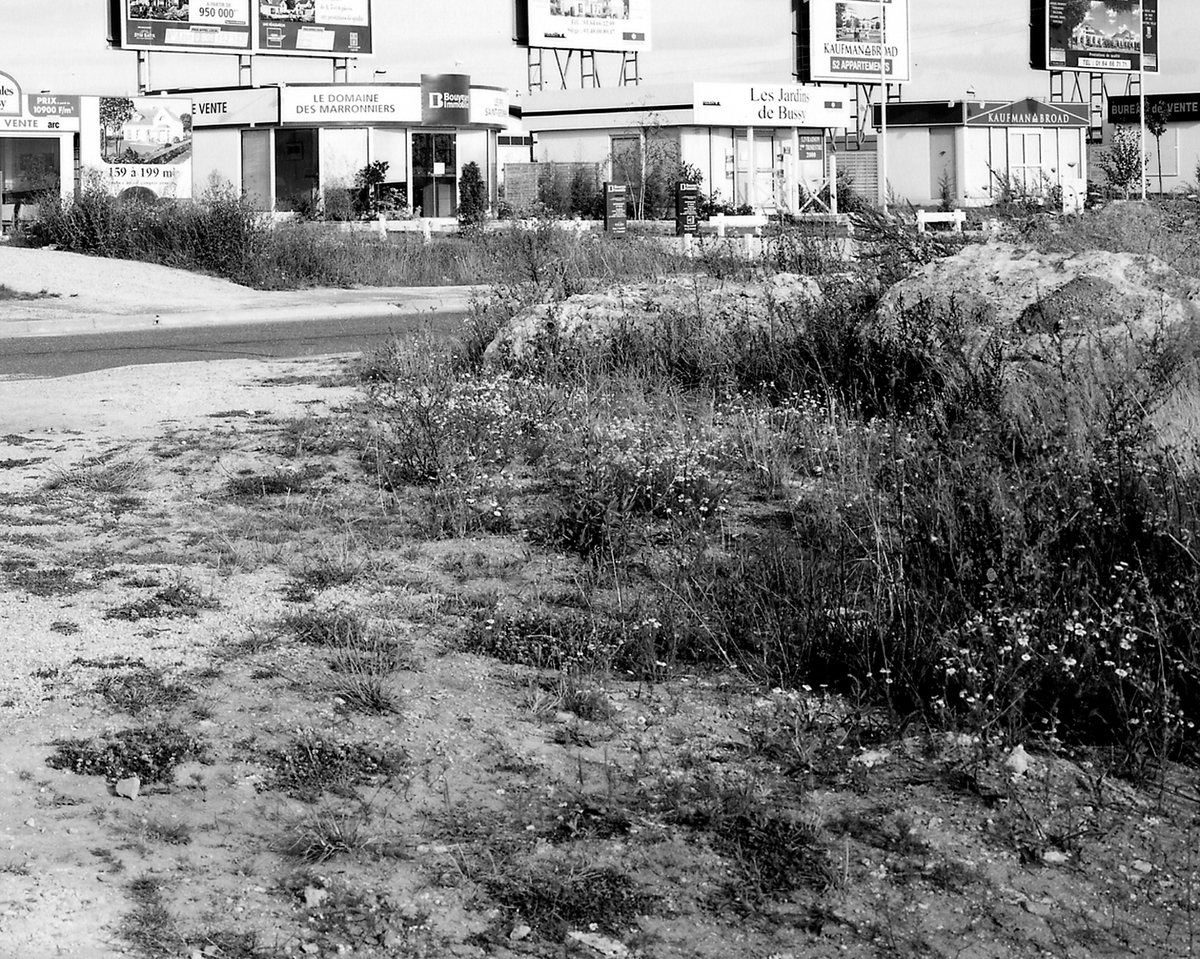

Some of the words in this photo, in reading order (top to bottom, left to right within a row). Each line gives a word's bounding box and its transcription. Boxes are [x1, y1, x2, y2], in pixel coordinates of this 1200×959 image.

[199, 7, 216, 17] 950
[218, 7, 234, 18] 000
[824, 43, 865, 55] KAUFMAN
[832, 60, 840, 69] 52
[313, 94, 324, 102] LE
[328, 94, 379, 103] DOMAINE
[751, 88, 774, 102] Les
[778, 87, 810, 103] Jardins
[33, 106, 57, 114] 10900
[199, 102, 227, 115] VENTE
[296, 105, 316, 114] DES
[319, 104, 396, 114] MARRONNIERS
[1152, 103, 1162, 114] de
[1167, 101, 1199, 113] VENTE
[758, 105, 774, 119] de
[778, 105, 806, 123] Bussy
[988, 113, 1031, 123] KAUFMAN
[1040, 113, 1070, 123] BROAD
[4, 119, 38, 128] VENTE
[47, 121, 60, 129] arc
[109, 167, 127, 178] 159
[130, 166, 136, 177] à
[141, 167, 160, 178] 199
